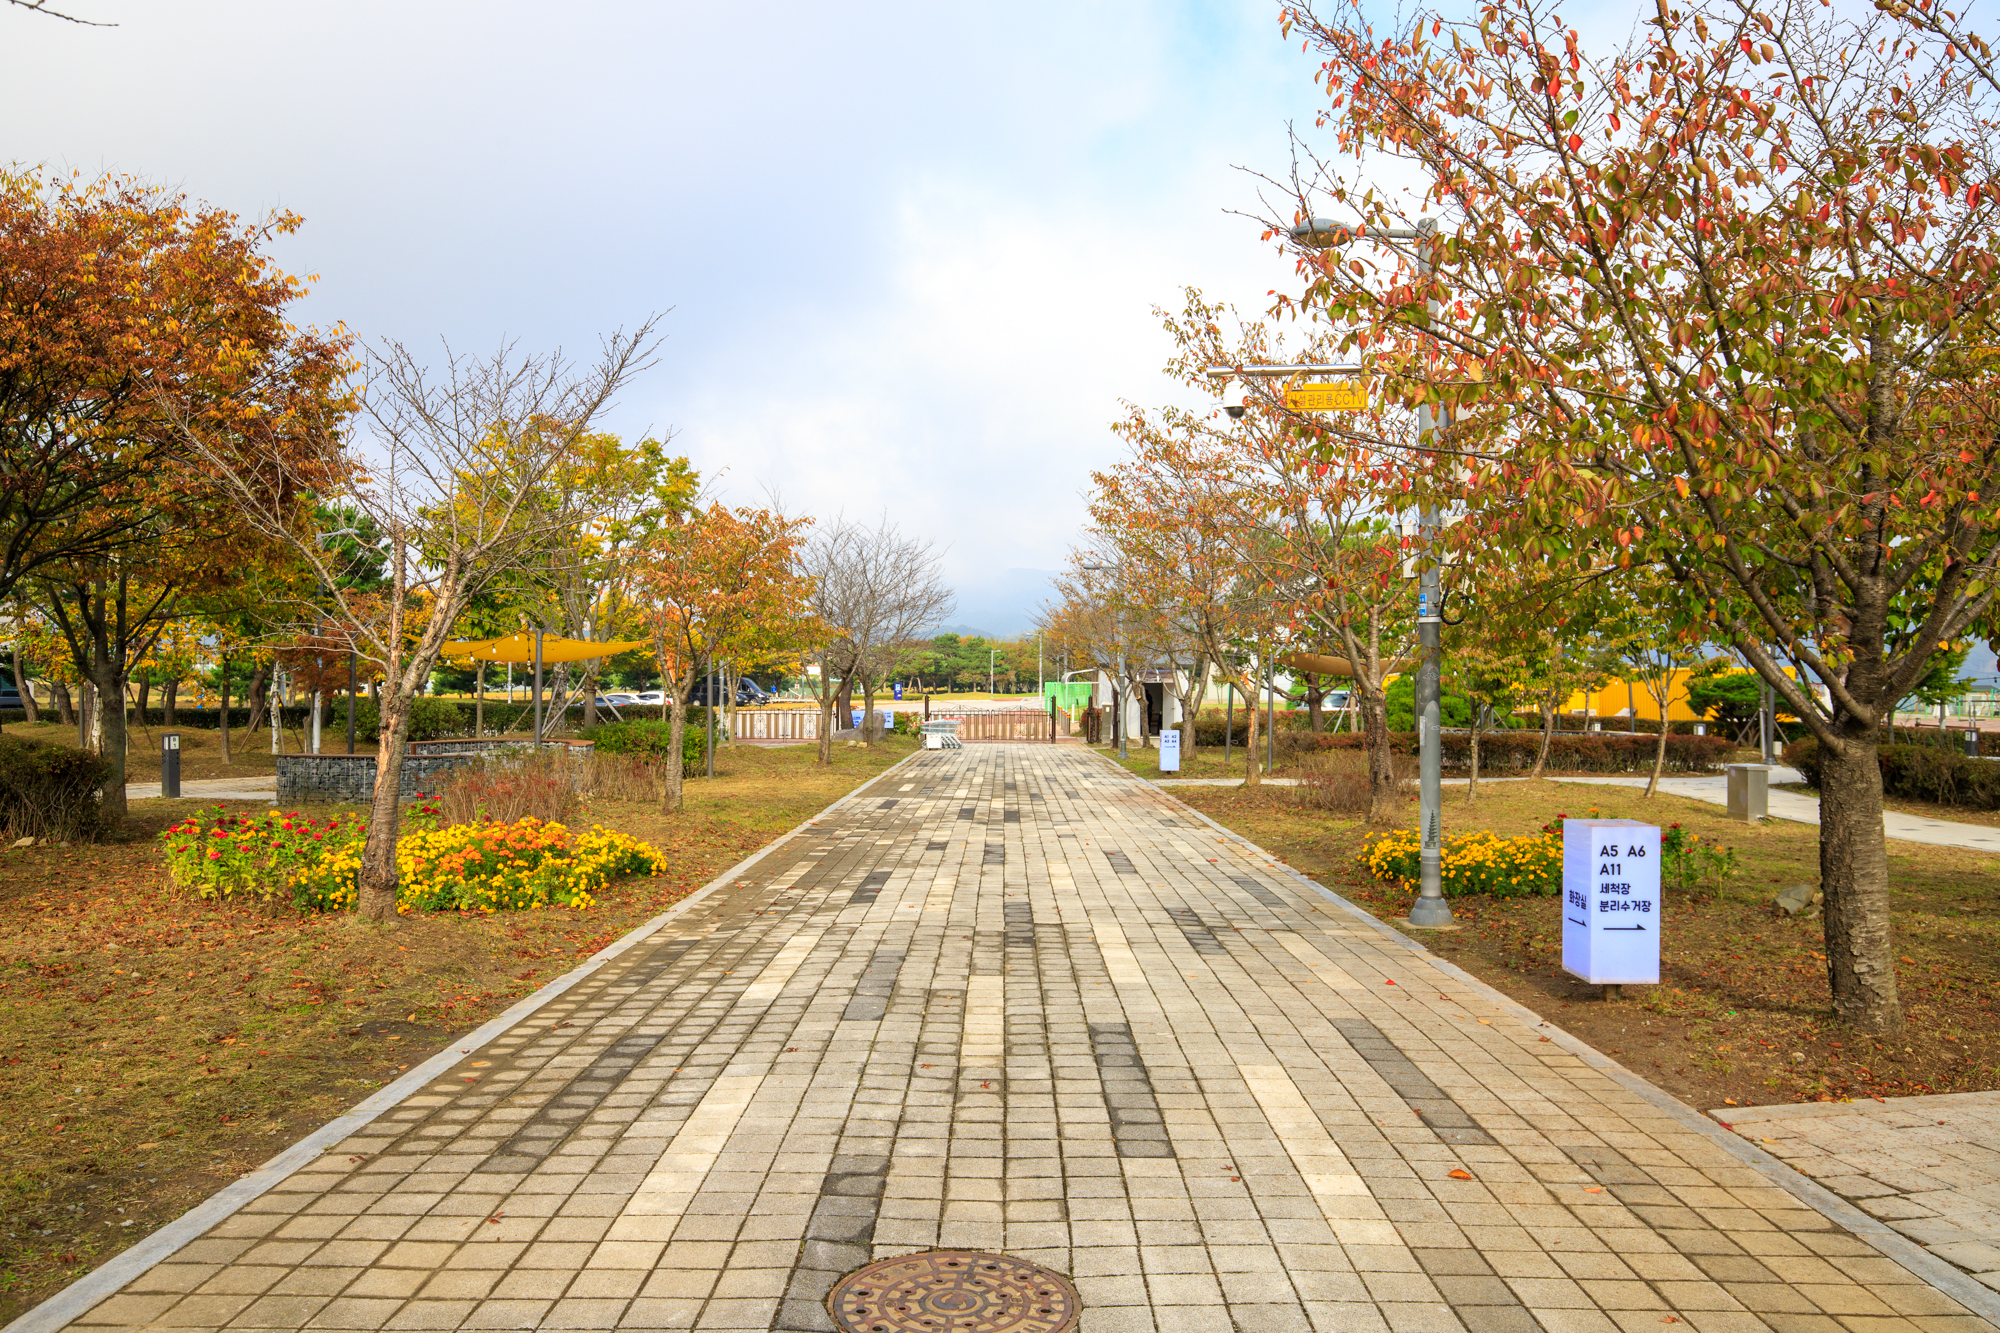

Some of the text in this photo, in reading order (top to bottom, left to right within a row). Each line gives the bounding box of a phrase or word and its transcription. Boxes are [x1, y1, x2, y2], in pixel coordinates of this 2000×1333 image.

[1600, 845, 1646, 857] A5 A6
[1600, 864, 1620, 876] A11
[1600, 883, 1631, 895] 세척장
[1569, 890, 1586, 910] 화장실
[1600, 900, 1652, 912] 분리수거장
